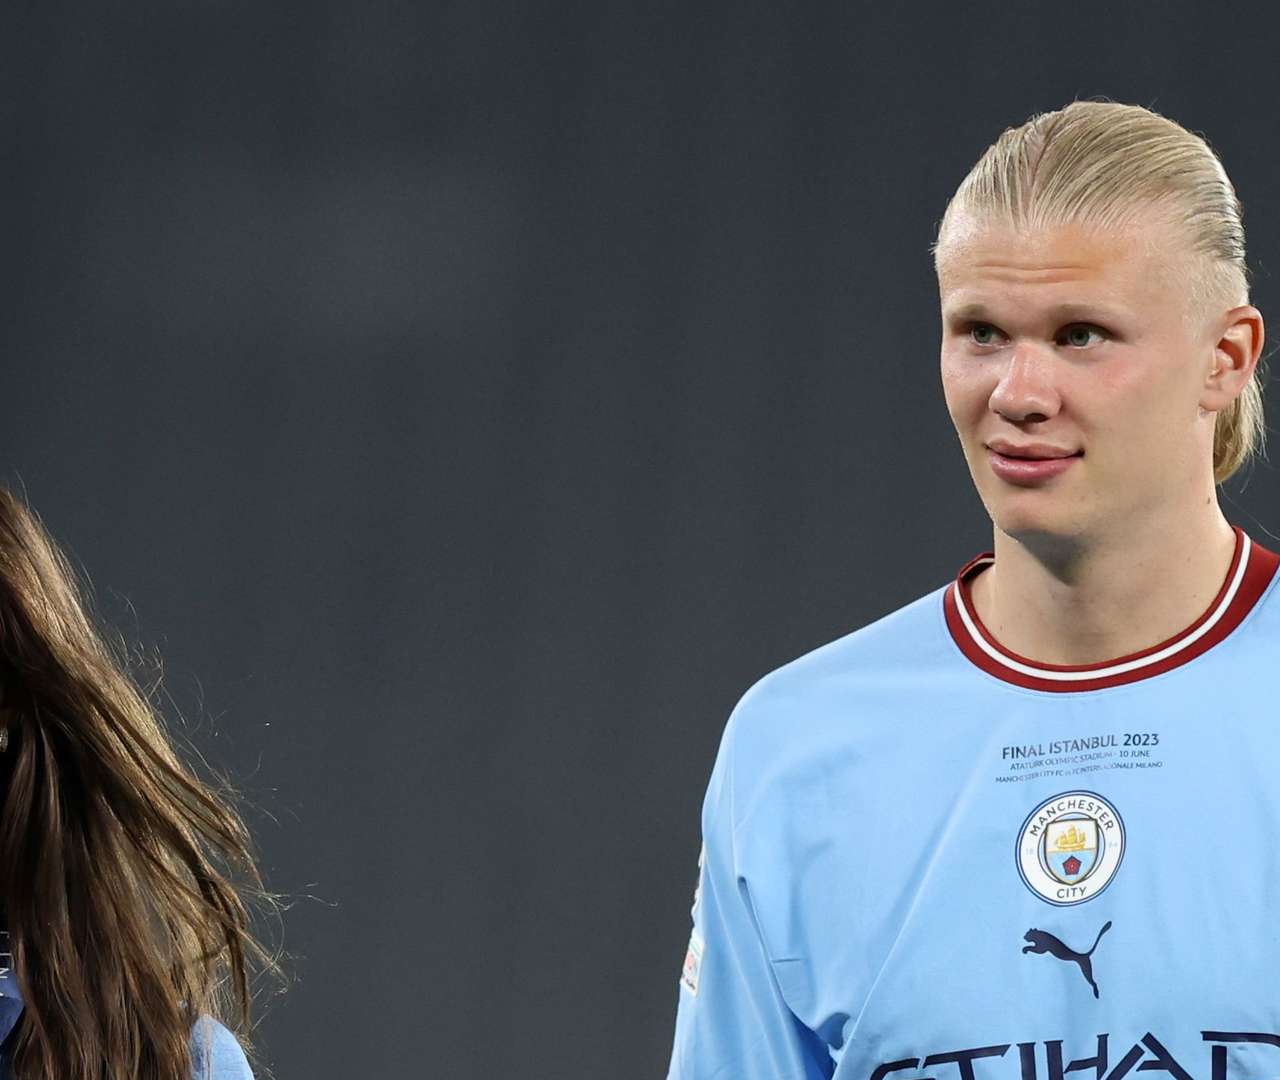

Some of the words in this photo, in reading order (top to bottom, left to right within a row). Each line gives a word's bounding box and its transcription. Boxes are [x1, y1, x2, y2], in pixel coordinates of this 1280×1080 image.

[1002, 744, 1046, 760] FINAL
[1049, 734, 1119, 754] ISTANBUL
[1122, 733, 1160, 747] 2023
[1130, 750, 1150, 758] JUNE
[1030, 799, 1114, 837] MANCHESTER
[1056, 886, 1087, 899] CITY
